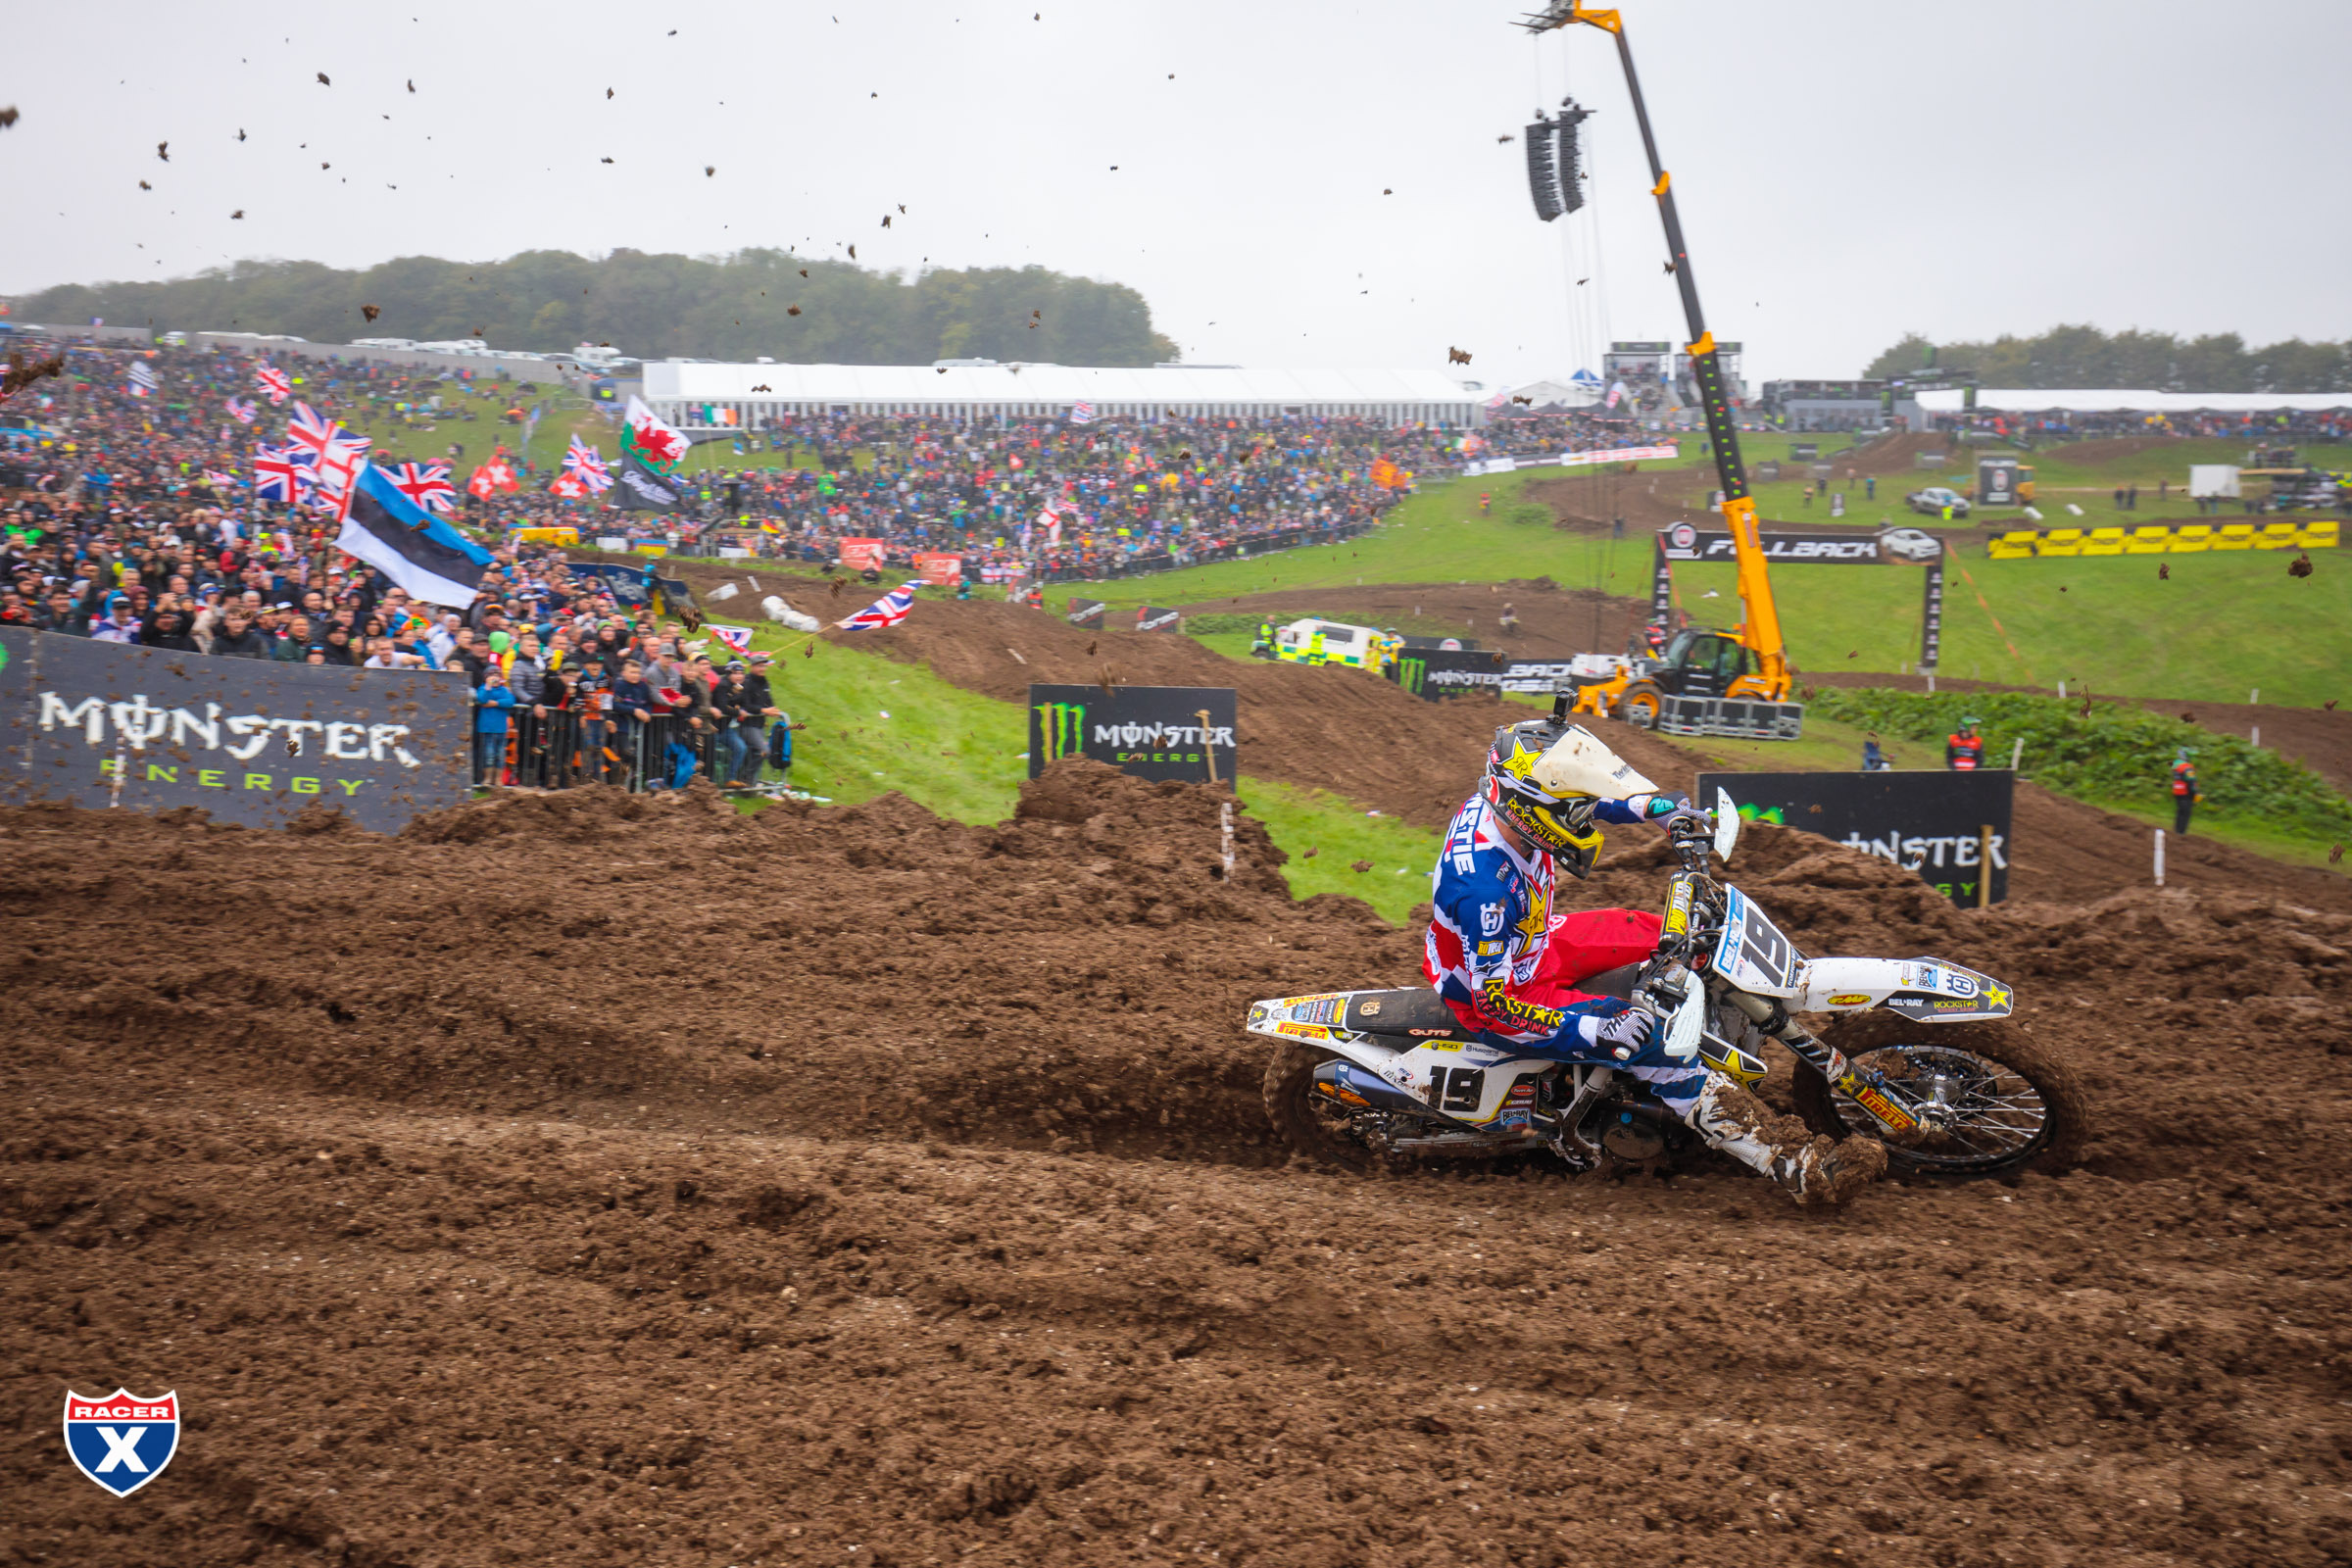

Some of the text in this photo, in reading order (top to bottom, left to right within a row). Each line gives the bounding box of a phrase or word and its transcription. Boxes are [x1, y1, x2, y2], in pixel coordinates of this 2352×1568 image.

[1706, 540, 1877, 558] FLLBACK
[38, 691, 421, 768] MONSTER
[1094, 721, 1237, 748] MONSTER
[1116, 753, 1219, 762] EERG
[100, 760, 364, 796] ENERGY
[1451, 792, 1483, 876] NSTIE
[1505, 808, 1534, 837] ENERGY
[1532, 833, 1555, 853] DRINK
[1507, 797, 1567, 849] ROCKSTAR
[1838, 830, 2007, 871] ONSTER
[1740, 906, 1787, 988] 19
[1934, 1000, 1979, 1009] ROCKSTAR
[1278, 1022, 1326, 1040] PIRLLI
[1408, 1028, 1453, 1037] GUTS
[1510, 1015, 1549, 1036] DRINK
[1427, 1065, 1485, 1112] 19
[1859, 1088, 1909, 1132] PIRELL
